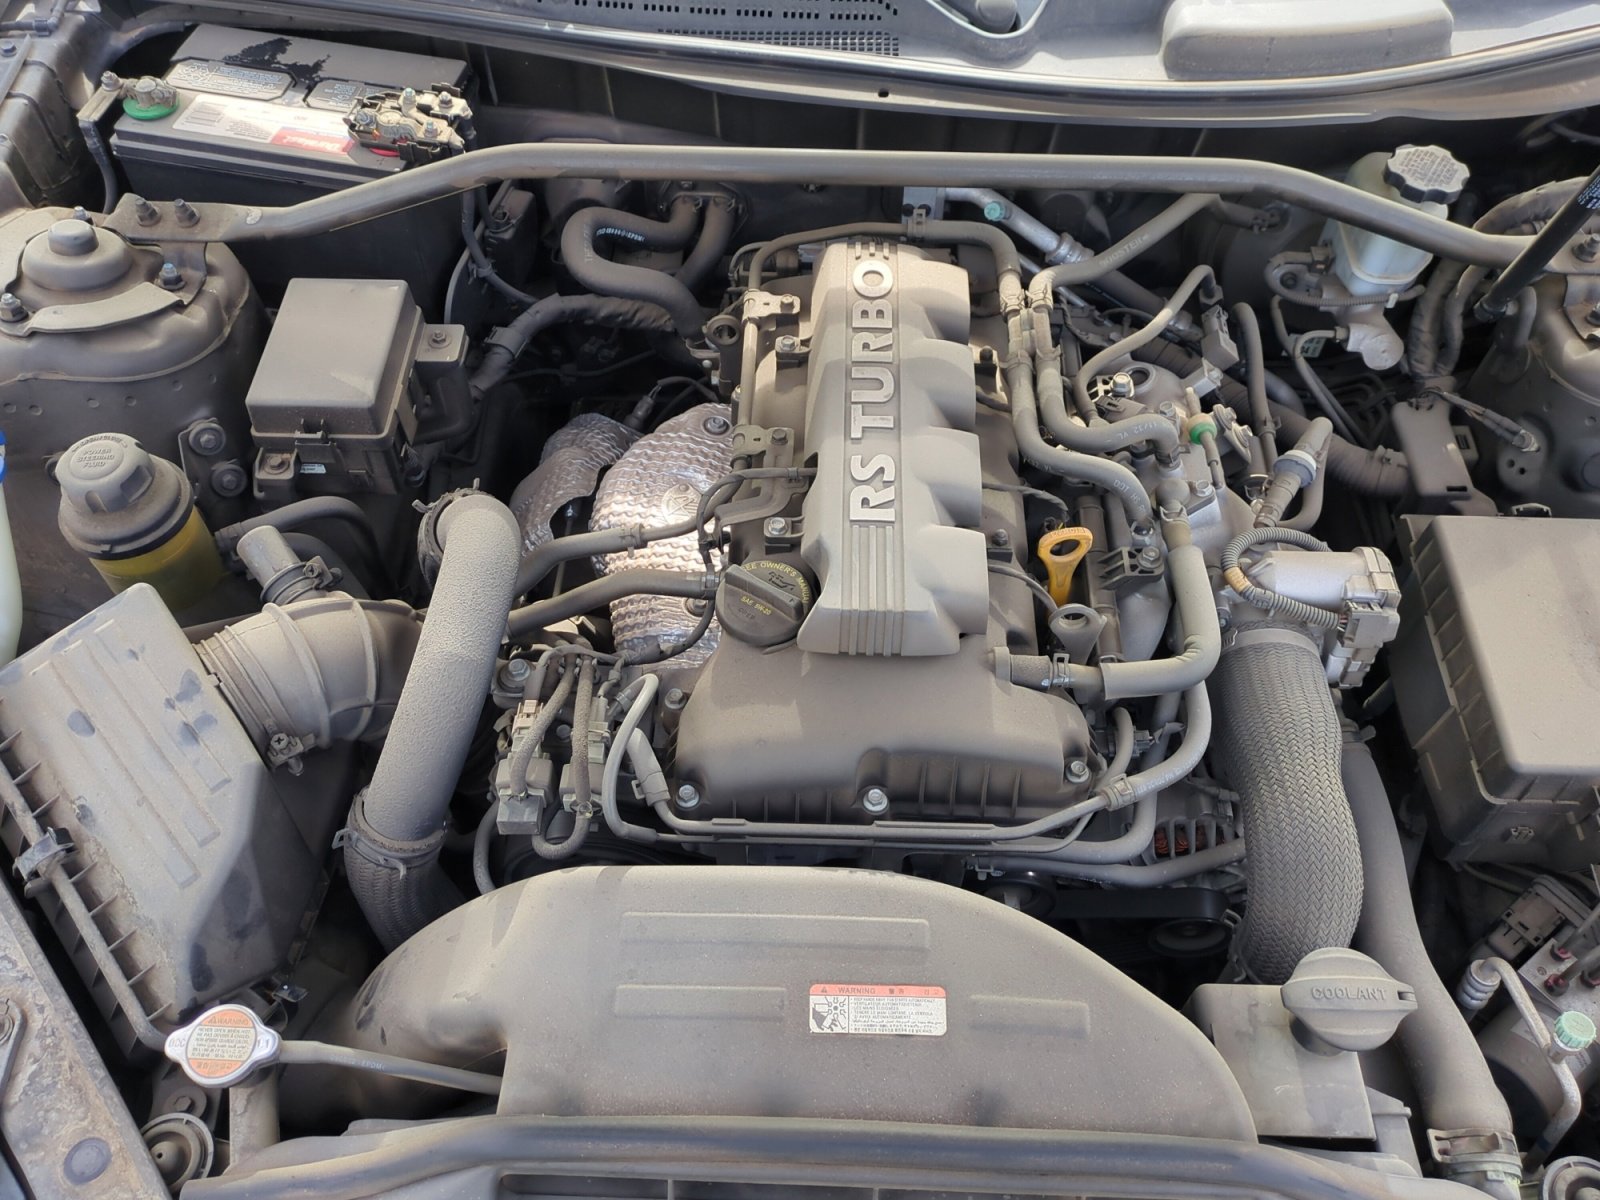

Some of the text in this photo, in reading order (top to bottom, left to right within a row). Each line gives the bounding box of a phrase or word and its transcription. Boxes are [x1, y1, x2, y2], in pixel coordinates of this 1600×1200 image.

[850, 259, 896, 522] RS TURBO
[76, 454, 115, 462] STEERING
[760, 560, 797, 578] OWNER'S
[740, 596, 754, 606] SAE
[838, 986, 876, 995] WARNING
[1312, 986, 1387, 1001] COOLANT
